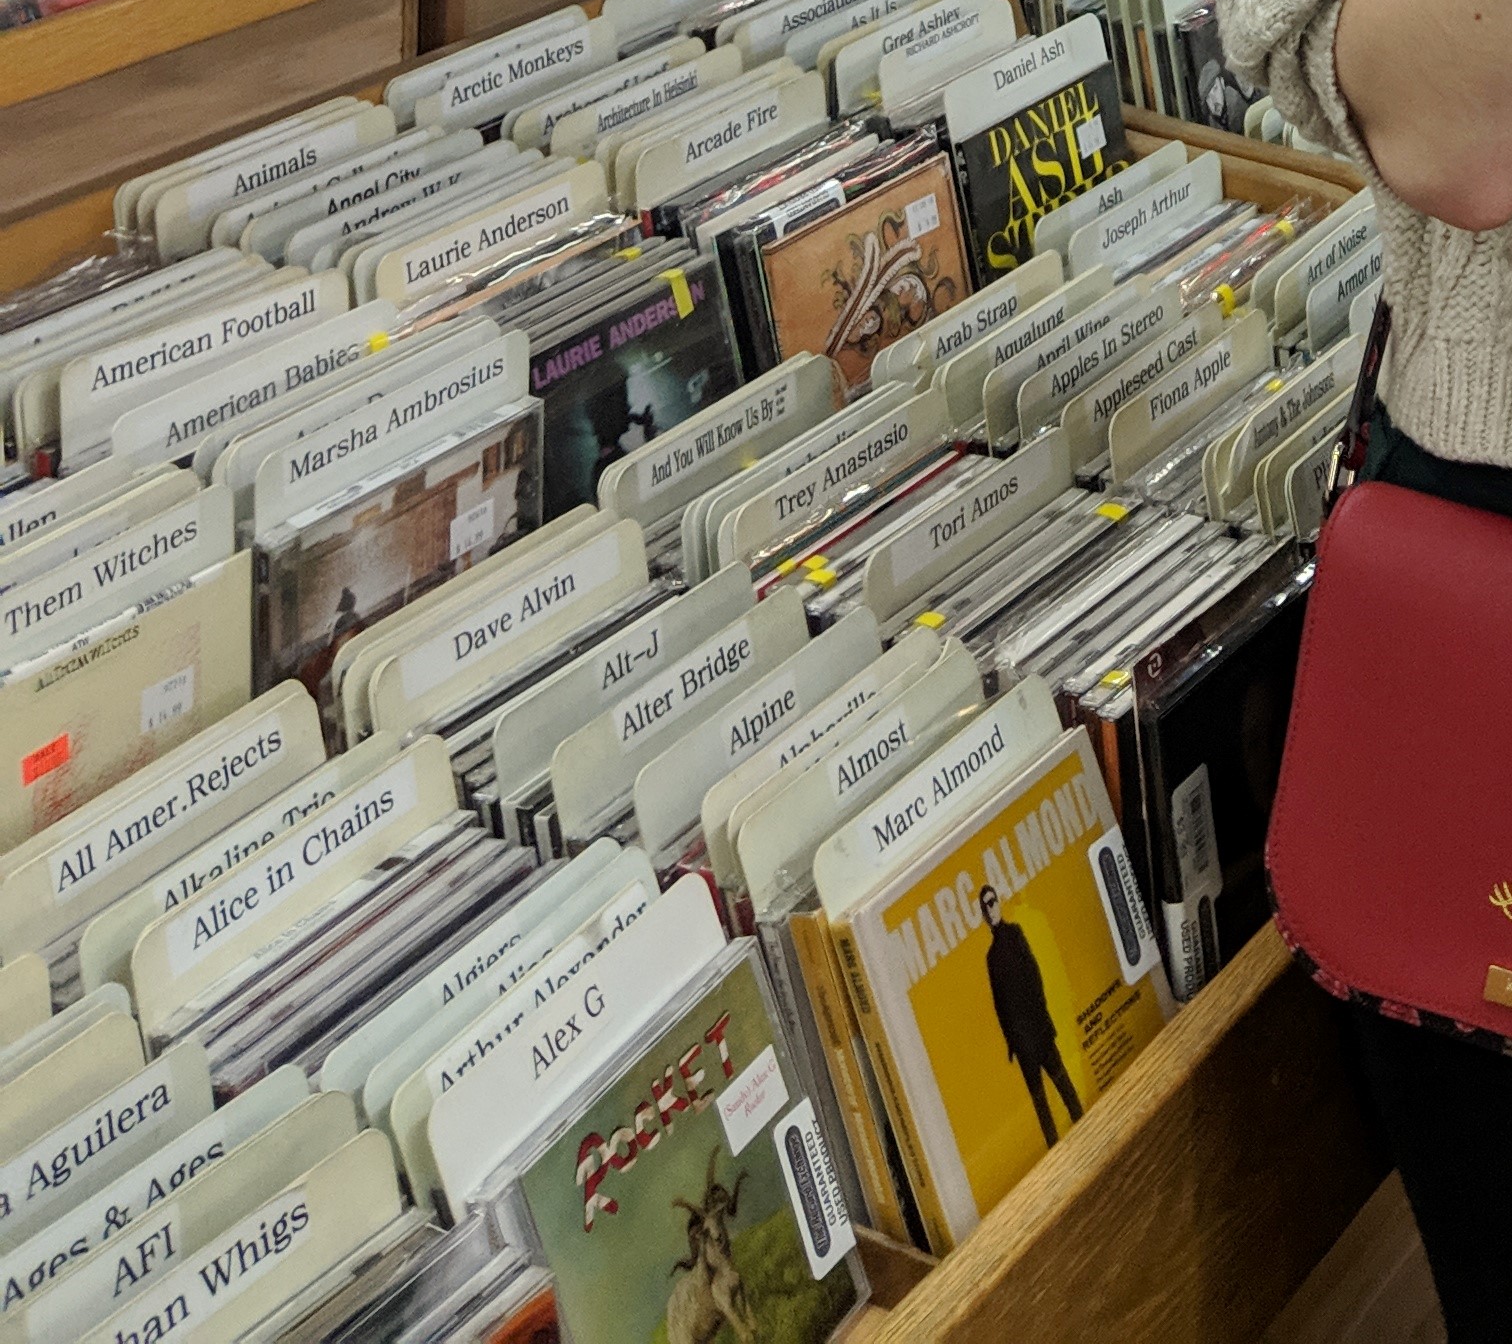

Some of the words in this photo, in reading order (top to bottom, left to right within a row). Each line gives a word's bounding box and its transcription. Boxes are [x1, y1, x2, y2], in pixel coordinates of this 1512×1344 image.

[851, 15, 868, 30] As
[871, 4, 883, 24] It
[882, 17, 915, 54] Greg
[918, 6, 961, 36] Ashley
[905, 31, 941, 58] RICHARD
[941, 13, 981, 44] ASHCROFT
[449, 67, 504, 108] Arctic
[507, 36, 586, 85] Monkeys
[596, 93, 651, 133] Architecture
[652, 87, 664, 106] In
[664, 69, 699, 101] Helsinki
[992, 53, 1038, 91] Daniel
[1038, 38, 1066, 70] Ash
[685, 123, 744, 164] Arcade
[747, 102, 779, 132] Fire
[988, 80, 1100, 168] DANIEL
[232, 147, 318, 197] Animals
[1098, 187, 1124, 214] Ash
[1102, 209, 1148, 250] Joseph
[1150, 181, 1192, 218] Arthur
[404, 240, 472, 285] Laurie
[477, 194, 571, 252] Anderson
[1307, 262, 1325, 286] Art
[1325, 246, 1337, 269] of
[1337, 224, 1368, 258] Noise
[934, 321, 977, 360] Arab
[977, 292, 1019, 334] Strap
[1337, 268, 1369, 302] Armor
[91, 331, 213, 392] American
[221, 289, 317, 345] Football
[532, 335, 602, 390] LAURIE
[607, 280, 705, 350] ANDERSN
[994, 303, 1066, 366] Aqualung
[1050, 353, 1101, 398] Apples
[1101, 335, 1119, 358] In
[1119, 303, 1165, 348] Stereo
[1092, 356, 1164, 423] Appleseed
[1165, 326, 1198, 358] Cast
[166, 373, 278, 448] American
[285, 342, 361, 395] Babies
[288, 423, 378, 484] Marsha
[386, 356, 505, 435] Ambrosius
[1149, 379, 1191, 422] Fiona
[1192, 348, 1232, 395] Apple
[650, 459, 673, 487] And
[673, 444, 694, 476] You
[695, 429, 716, 461] Will
[715, 416, 746, 448] Know
[745, 407, 760, 430] Us
[760, 398, 775, 422] By
[774, 481, 819, 521] Trey
[822, 422, 909, 493] Anastasio
[930, 509, 968, 552] Tori
[969, 476, 1020, 530] Amos
[4, 581, 83, 636] Them
[93, 520, 198, 588] Witches
[453, 615, 513, 662] Dave
[519, 569, 577, 623] Alvin
[600, 629, 661, 691] Alt-J
[619, 687, 675, 743] Alter
[678, 638, 753, 700] Bridge
[728, 687, 797, 756] Alpine
[834, 717, 912, 797] Almost
[871, 804, 929, 854] Marc
[930, 723, 1007, 805] Almond
[56, 848, 97, 894] All
[191, 883, 261, 951] Alice
[266, 861, 296, 892] in
[301, 787, 397, 869] Chains
[887, 867, 987, 987] MARC
[982, 771, 1102, 903] ALMOND
[1116, 853, 1147, 940] GUARANTEED
[525, 1014, 584, 1081] Alex
[582, 984, 607, 1020] G
[25, 1082, 171, 1202] Aguilera
[575, 1009, 737, 1234] ROCKET
[805, 1130, 837, 1228] GUARANTEED
[1, 1234, 90, 1311] Ages
[103, 1204, 130, 1240] &
[146, 1141, 225, 1210] Ages
[112, 1222, 178, 1298] AFI
[198, 1202, 310, 1298] Whigs
